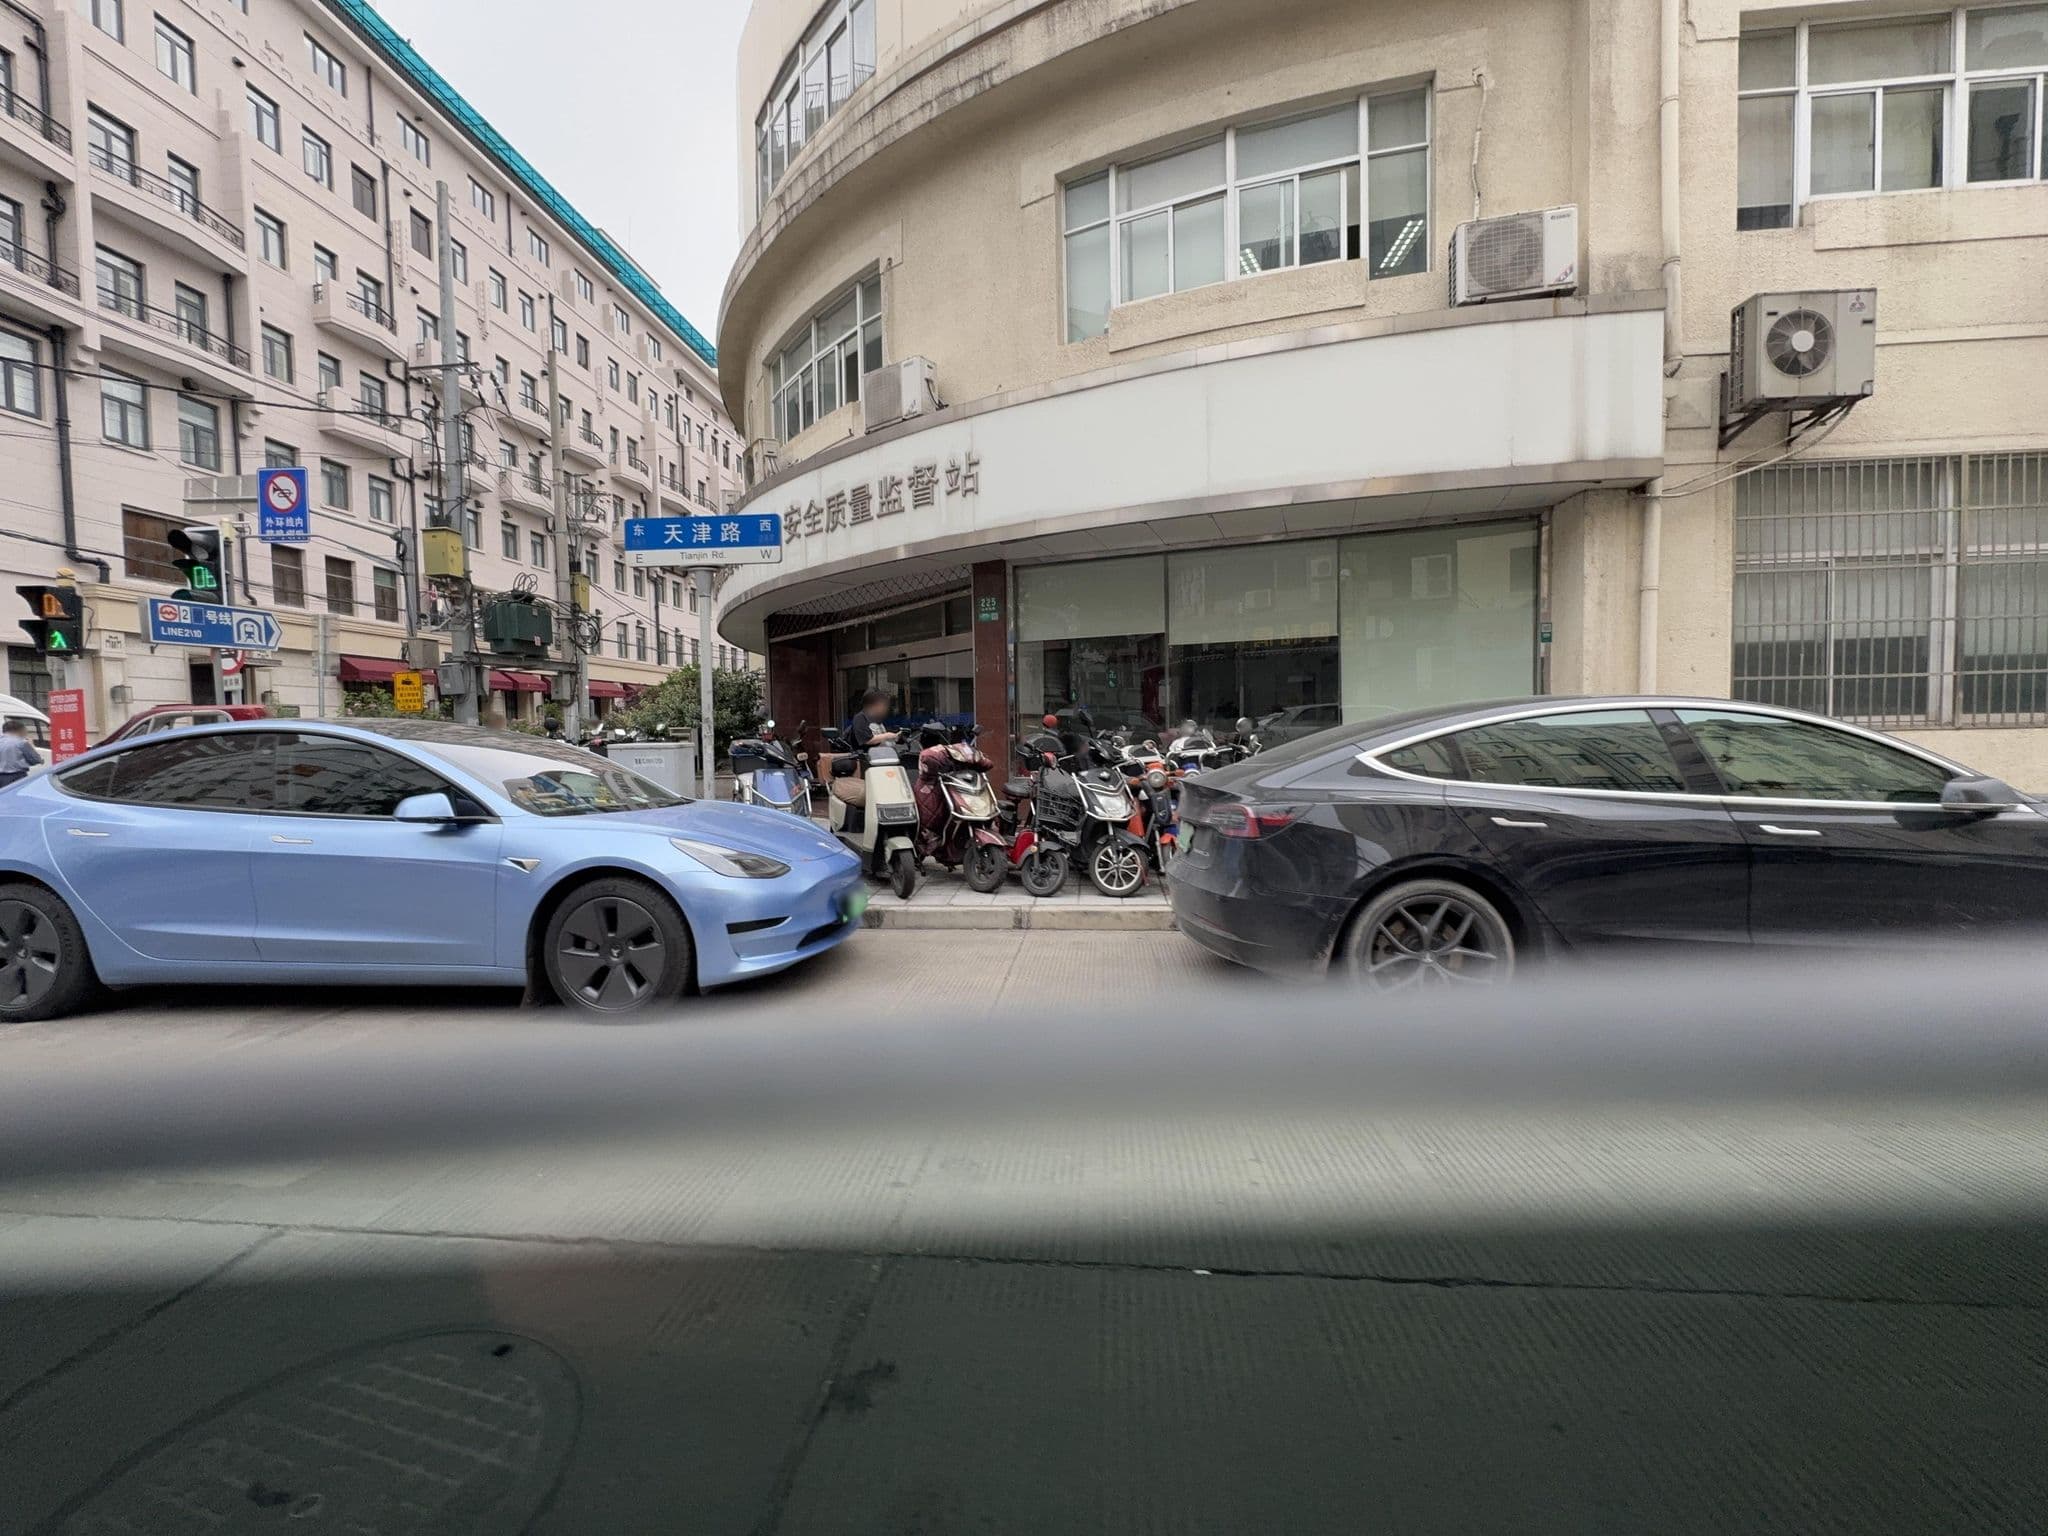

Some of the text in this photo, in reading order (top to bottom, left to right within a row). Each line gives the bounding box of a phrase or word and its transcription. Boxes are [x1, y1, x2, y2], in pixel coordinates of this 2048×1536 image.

[783, 451, 980, 545] 安全质量监督站
[633, 519, 772, 544] 东 天津路 西
[636, 549, 772, 564] E Tianjin Rd. W
[206, 609, 232, 626] 号线
